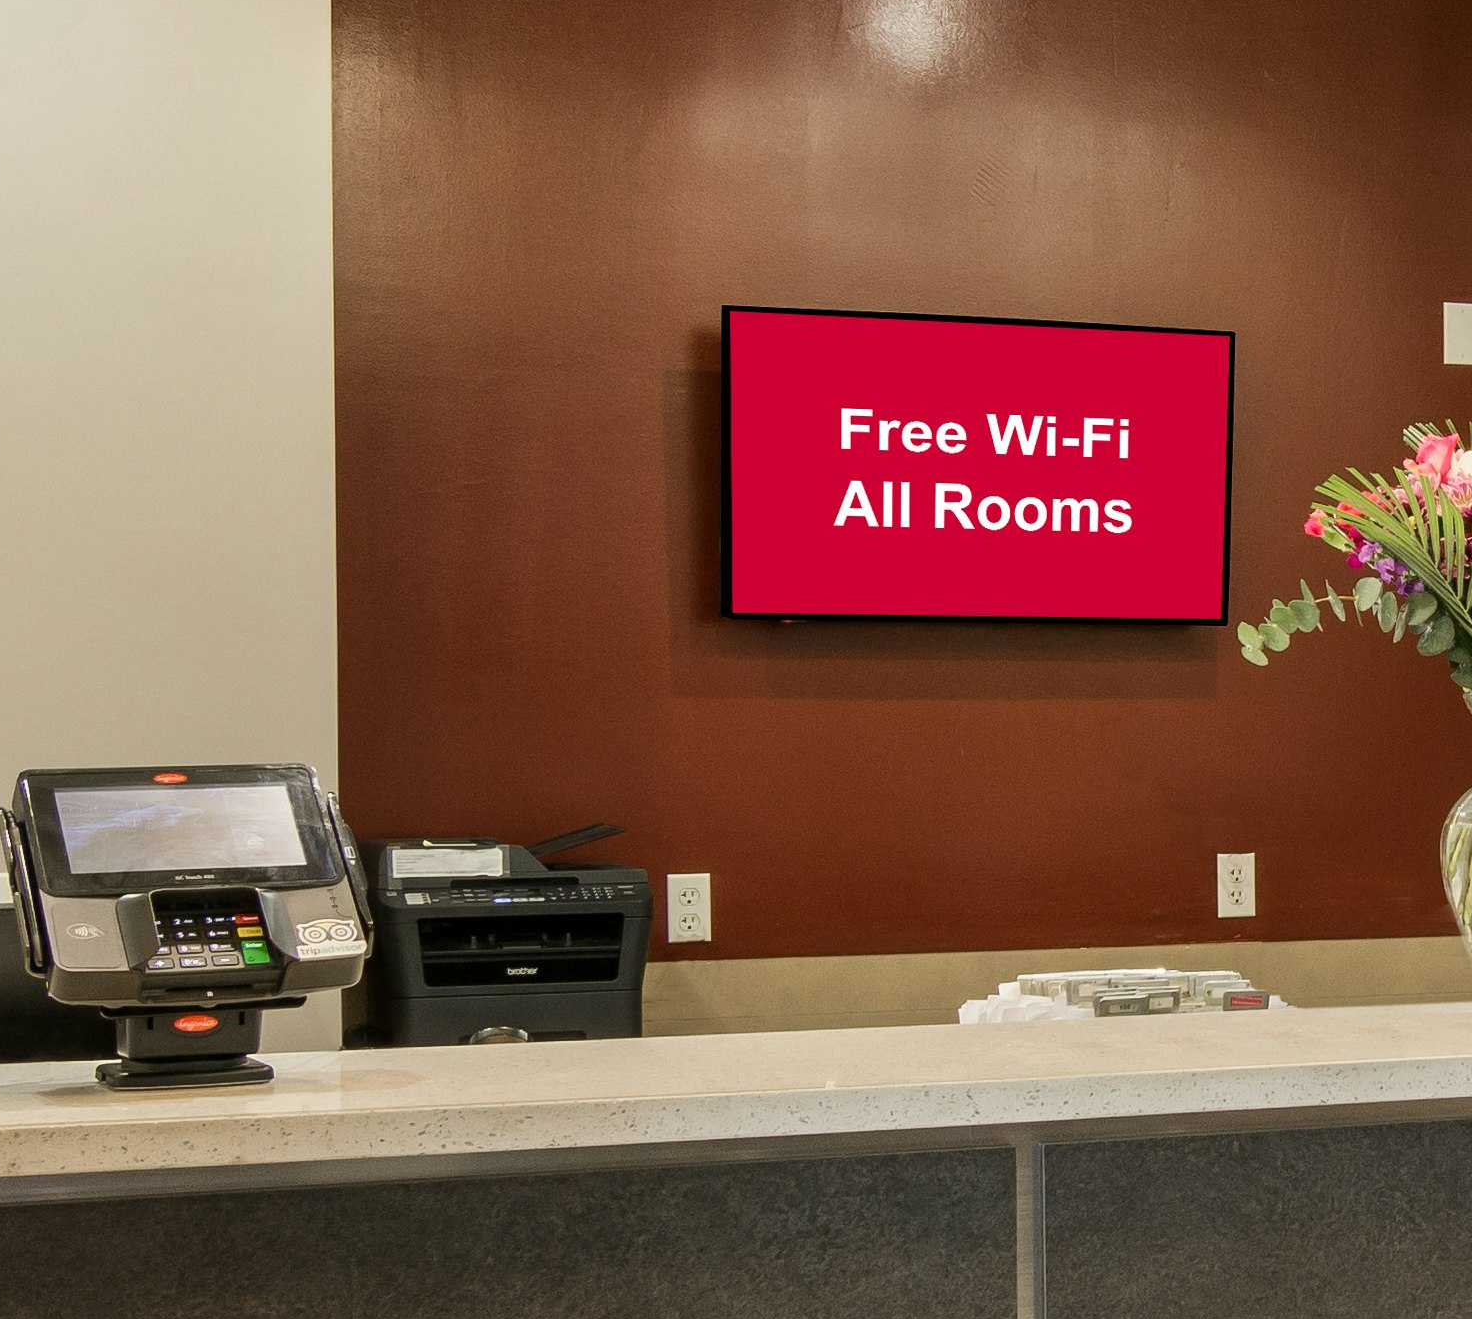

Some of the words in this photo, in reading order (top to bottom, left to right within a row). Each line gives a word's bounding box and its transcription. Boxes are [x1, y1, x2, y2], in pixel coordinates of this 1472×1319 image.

[840, 408, 967, 454] Free
[986, 413, 1130, 459] Wi-Fi
[833, 479, 910, 529] All
[933, 482, 1133, 534] Rooms
[300, 943, 362, 956] tripadvisor
